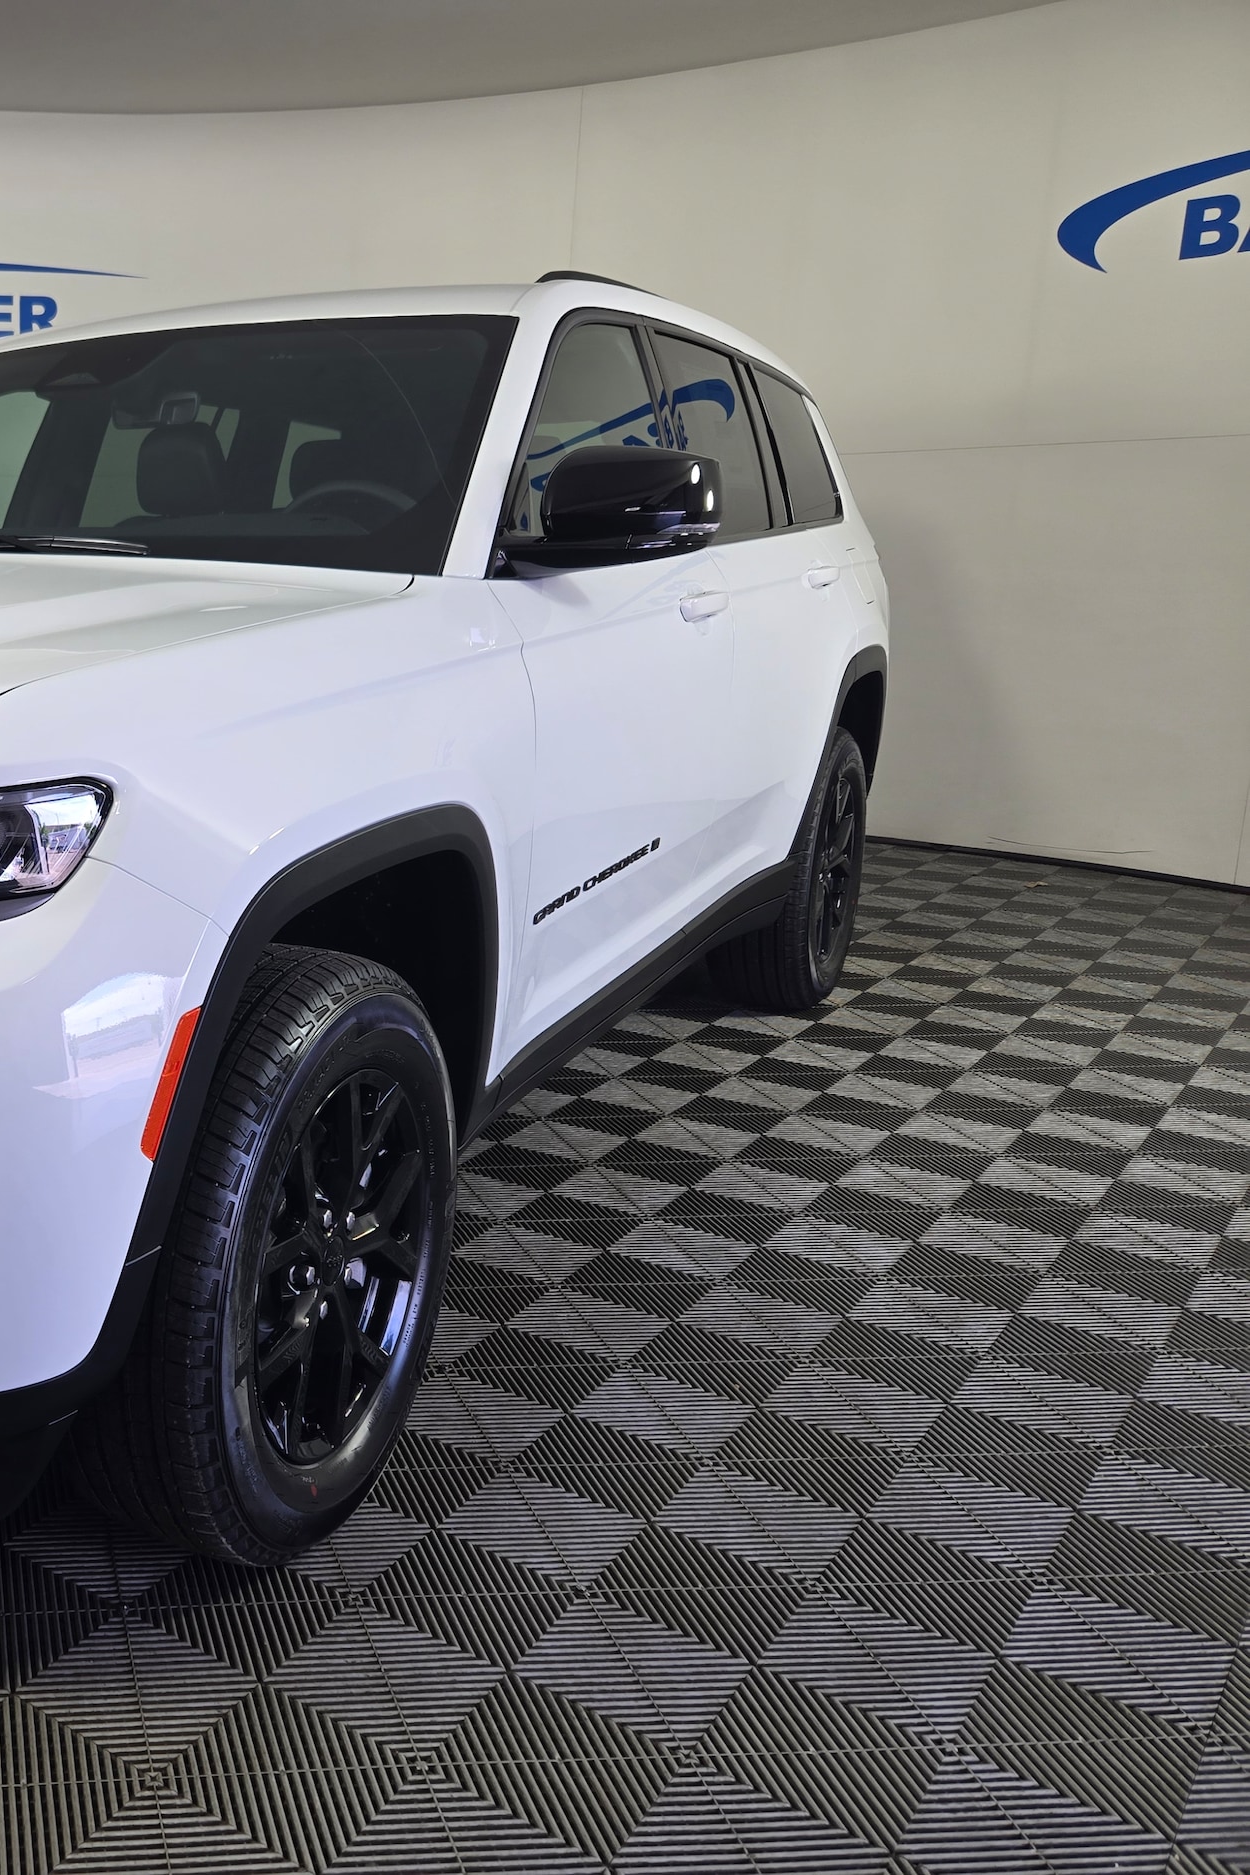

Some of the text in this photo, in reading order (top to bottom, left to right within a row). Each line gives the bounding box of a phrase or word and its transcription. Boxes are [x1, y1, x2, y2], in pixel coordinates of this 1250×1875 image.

[1178, 194, 1250, 261] B
[532, 843, 650, 926] GRAND CHEROKEE
